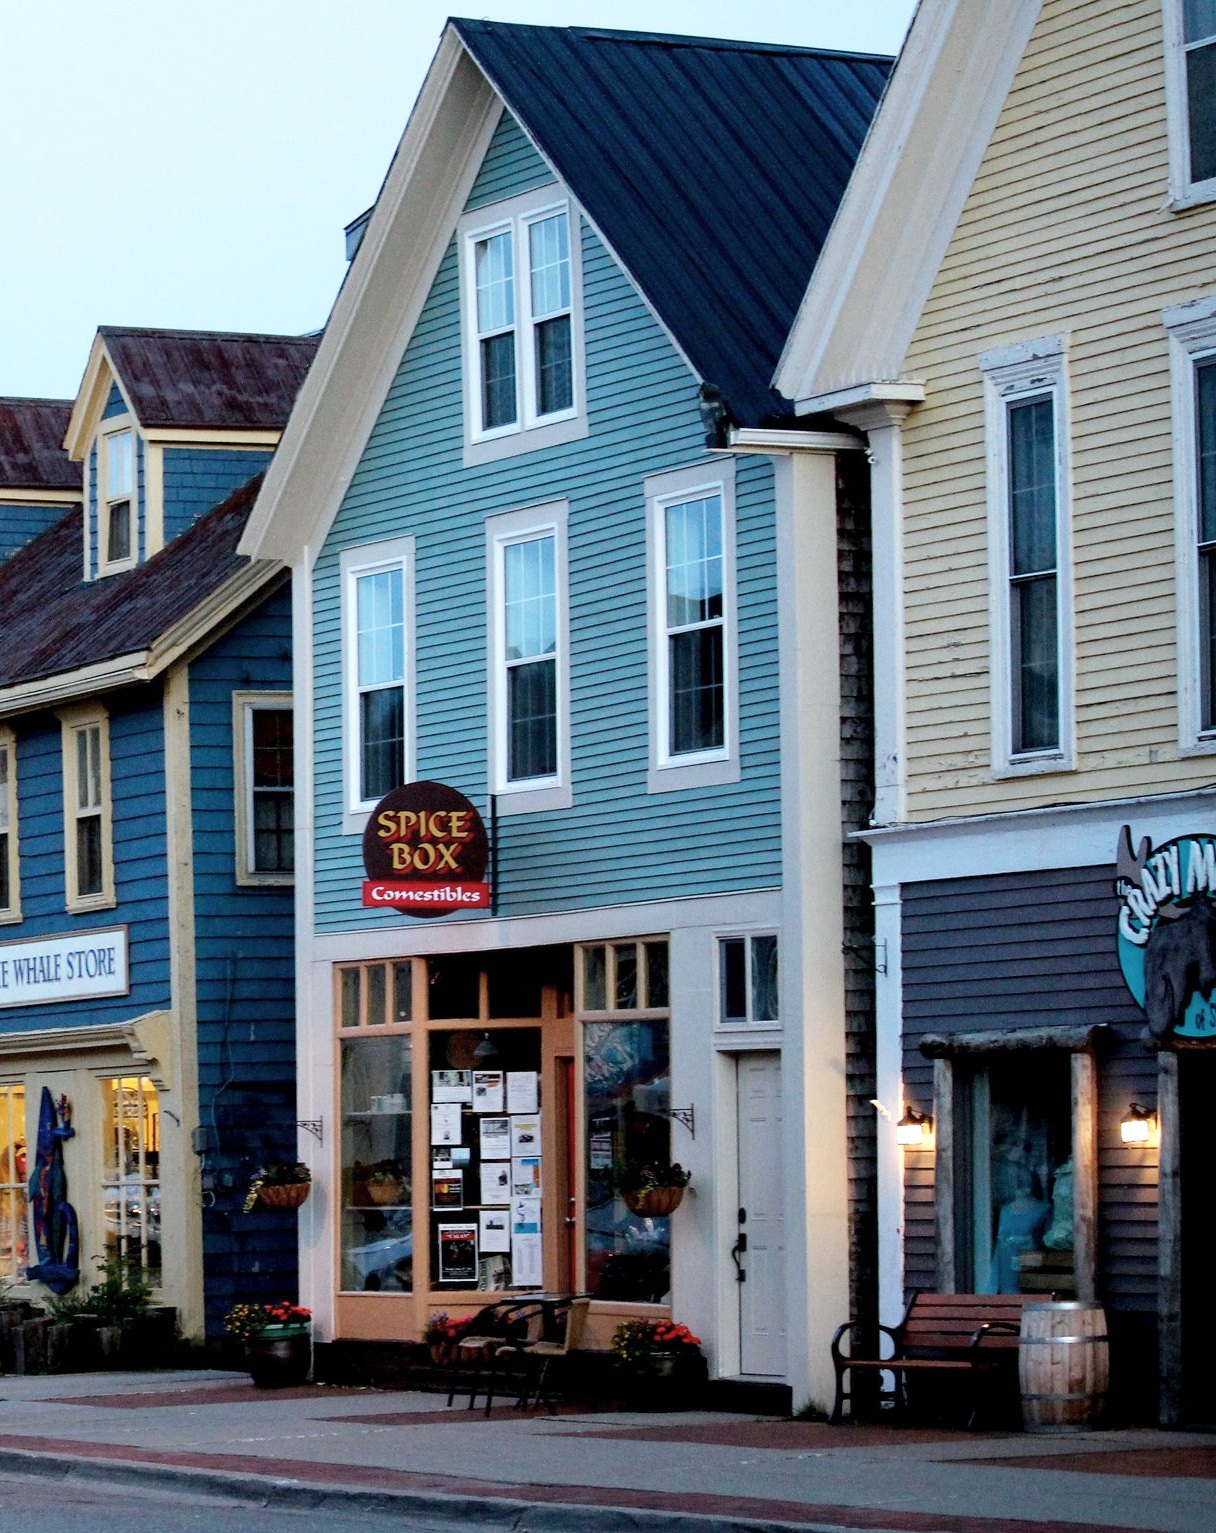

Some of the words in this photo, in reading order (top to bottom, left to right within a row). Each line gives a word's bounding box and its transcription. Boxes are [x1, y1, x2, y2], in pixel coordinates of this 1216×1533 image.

[377, 810, 472, 840] SPICE
[388, 842, 461, 872] BOX
[371, 886, 481, 902] Comestibles
[1118, 845, 1180, 945] CRAZY
[12, 953, 62, 987] WHALE
[66, 946, 116, 980] STORE
